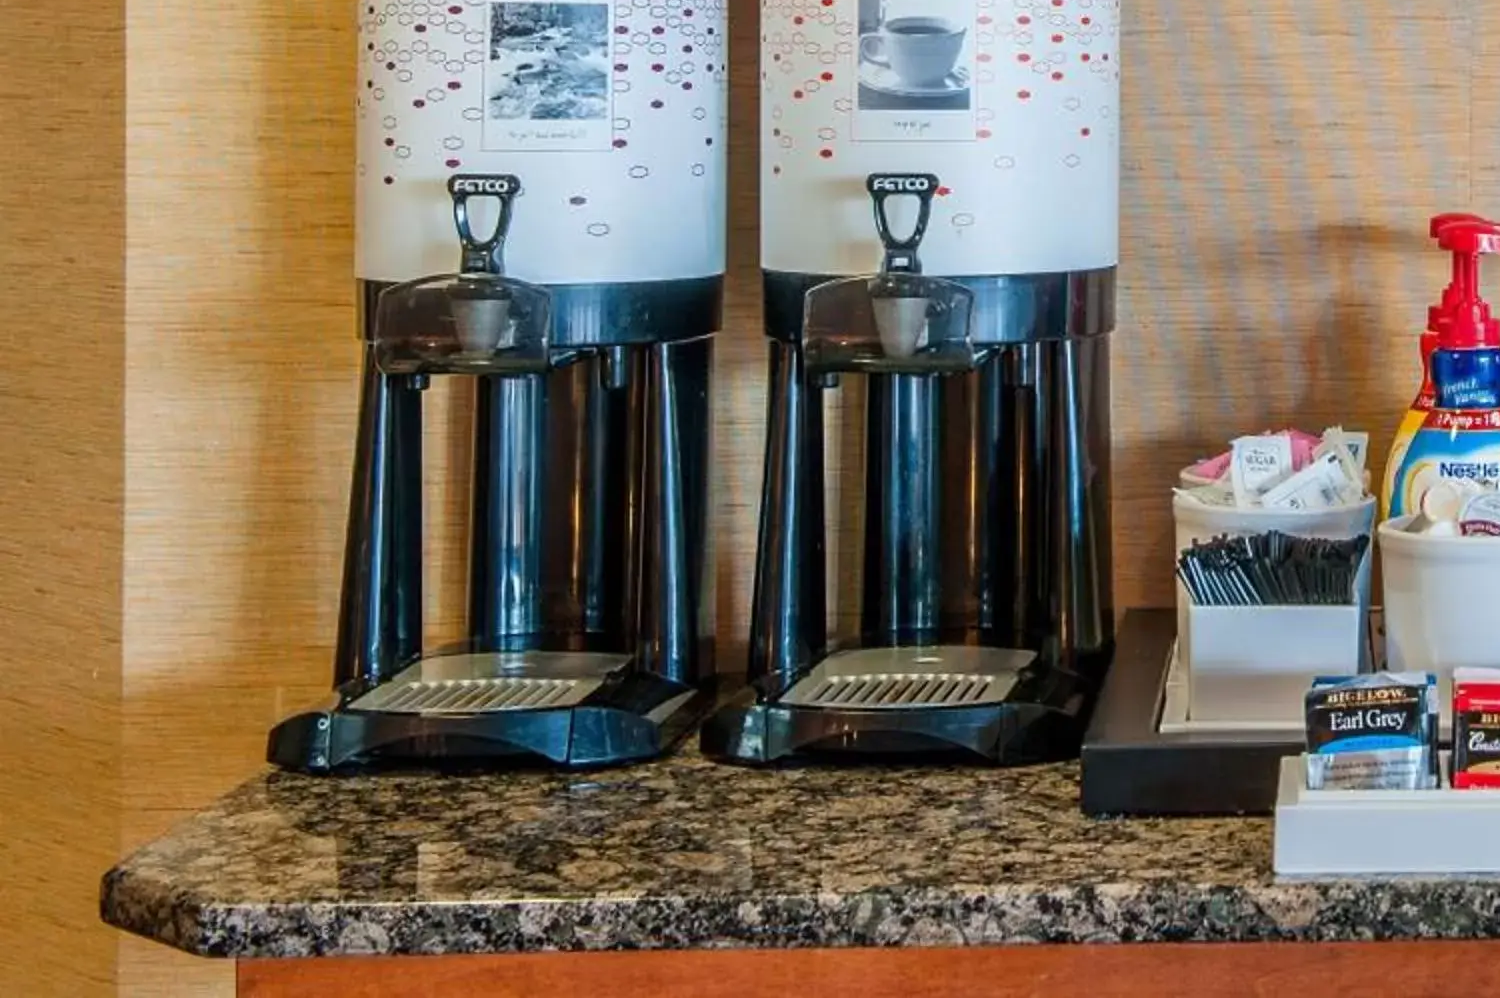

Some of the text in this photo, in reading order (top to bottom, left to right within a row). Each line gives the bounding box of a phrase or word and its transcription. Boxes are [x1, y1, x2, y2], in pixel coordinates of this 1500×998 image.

[454, 179, 509, 193] FETCO
[873, 177, 929, 191] FETCO
[1443, 413, 1473, 429] Pump
[1327, 688, 1407, 703] BIGELOW
[1330, 708, 1408, 731] Earl Grey
